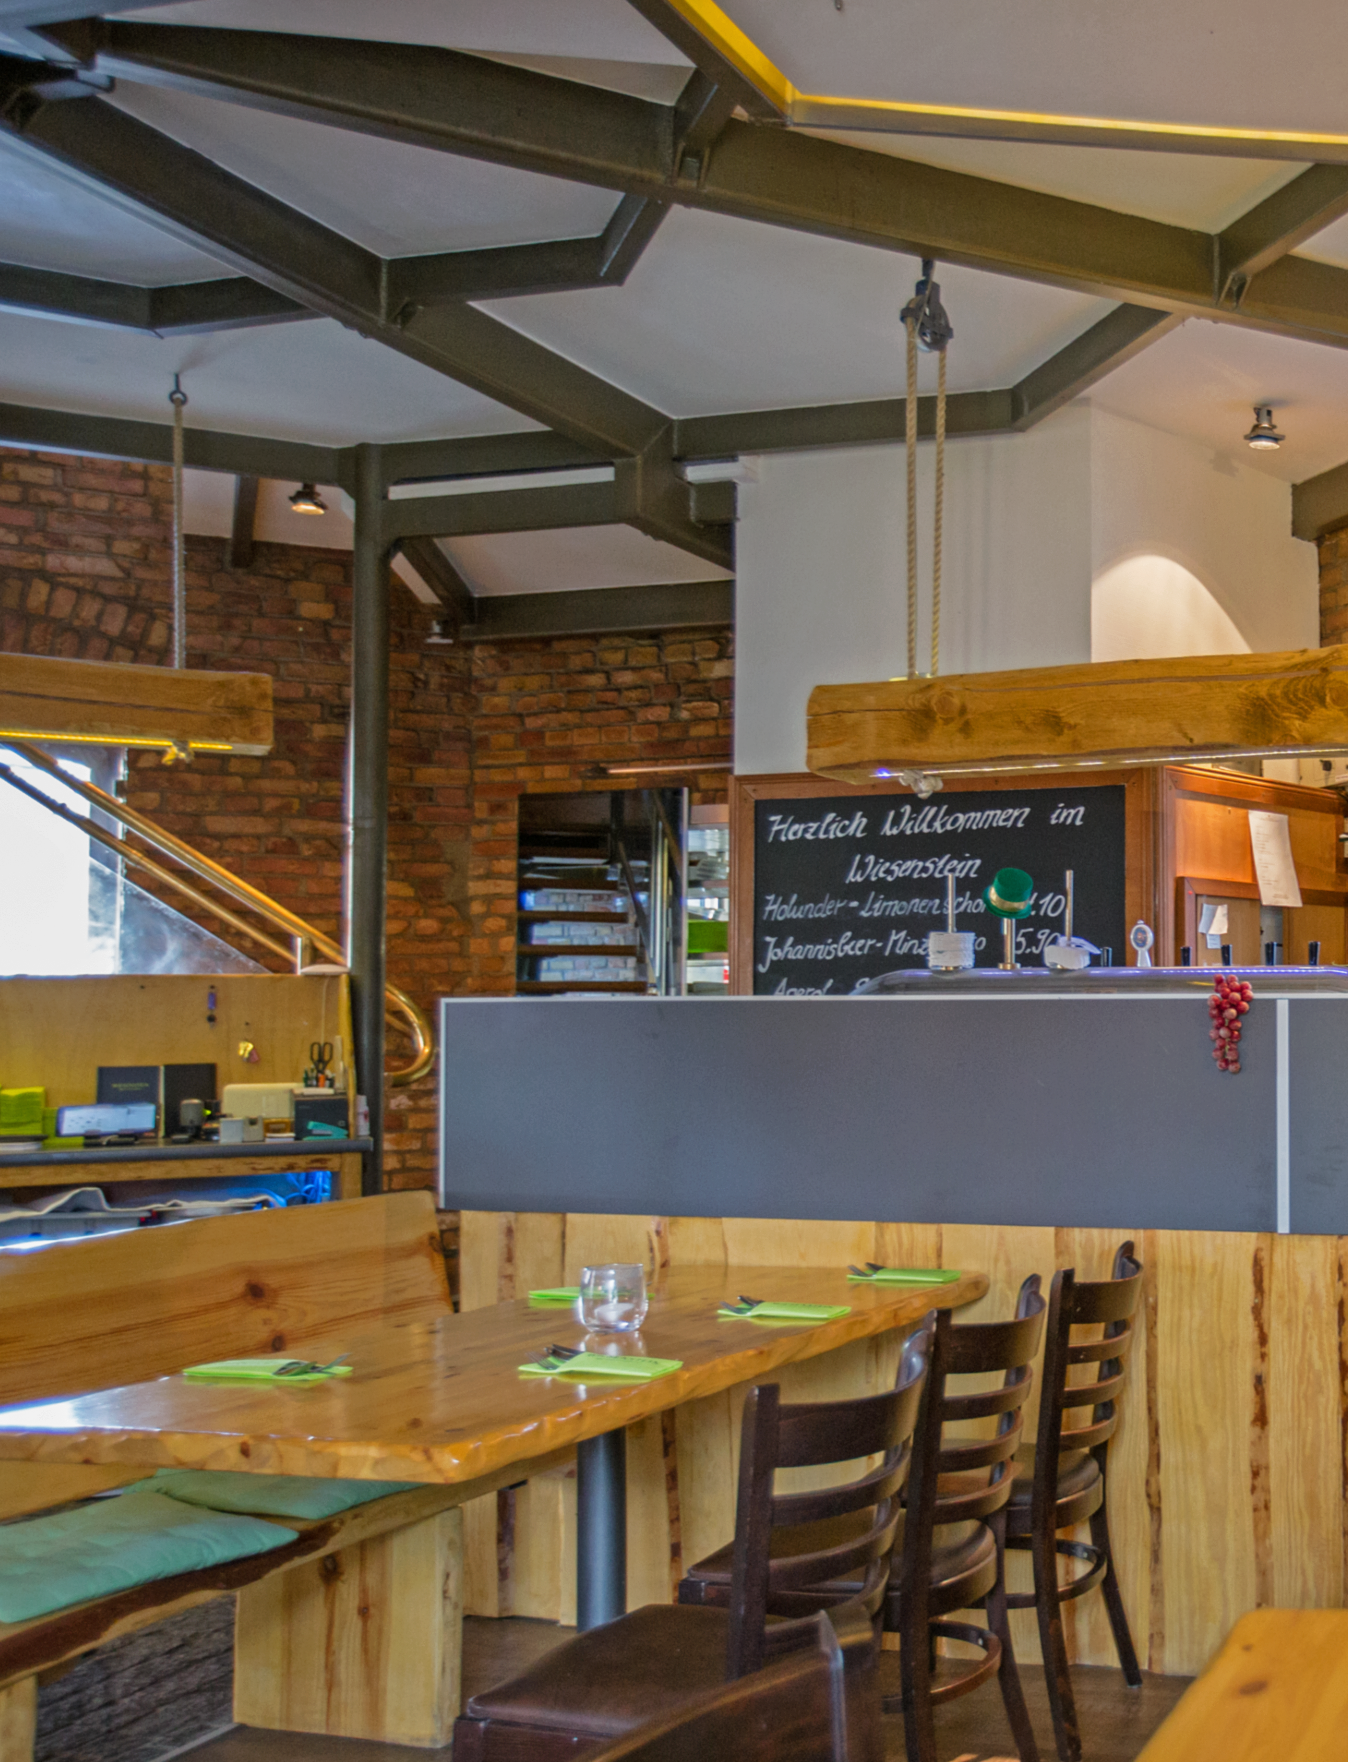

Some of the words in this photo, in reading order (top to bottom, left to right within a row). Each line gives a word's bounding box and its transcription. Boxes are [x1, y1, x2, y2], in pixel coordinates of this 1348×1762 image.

[767, 811, 868, 843] Herzlich
[880, 804, 1031, 837] Willkommen
[1049, 803, 1086, 827] im
[845, 853, 982, 884] Wiesenstein
[1031, 890, 1067, 918] .10
